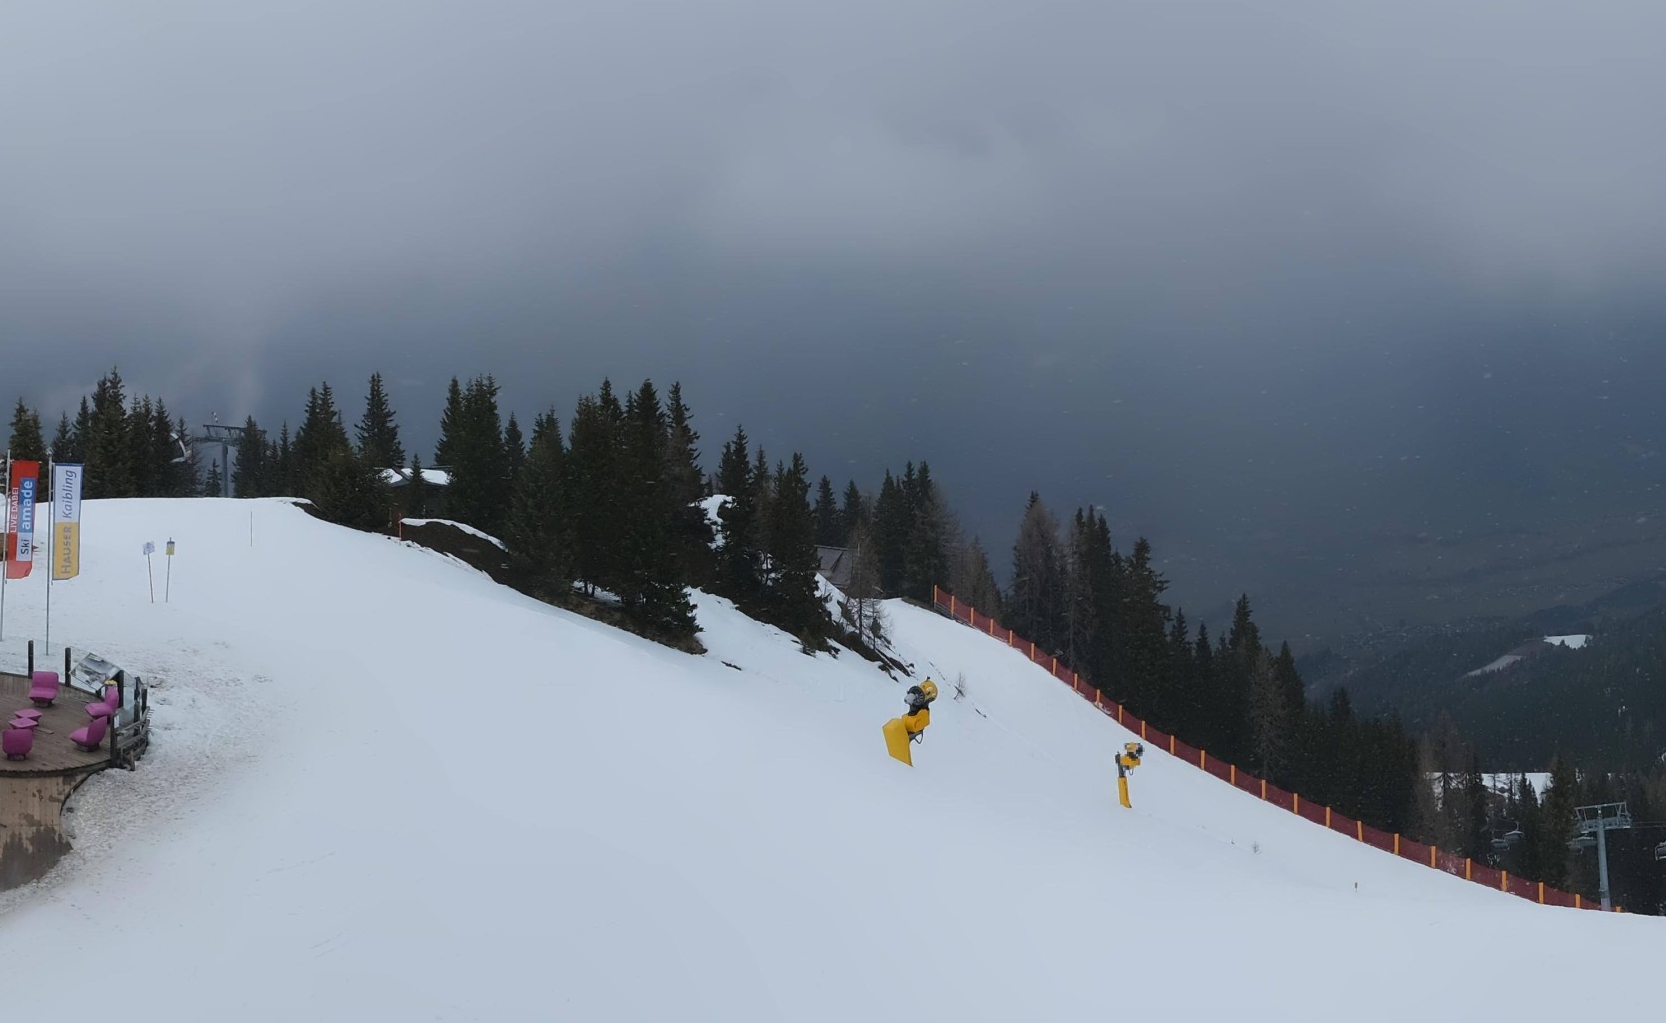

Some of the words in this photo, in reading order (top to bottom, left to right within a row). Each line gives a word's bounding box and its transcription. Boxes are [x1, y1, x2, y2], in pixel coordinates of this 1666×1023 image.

[21, 480, 33, 530] amade
[62, 470, 77, 519] Kaibling
[10, 511, 18, 533] LIVE
[21, 539, 29, 555] Ski
[61, 526, 72, 574] HAUSER
